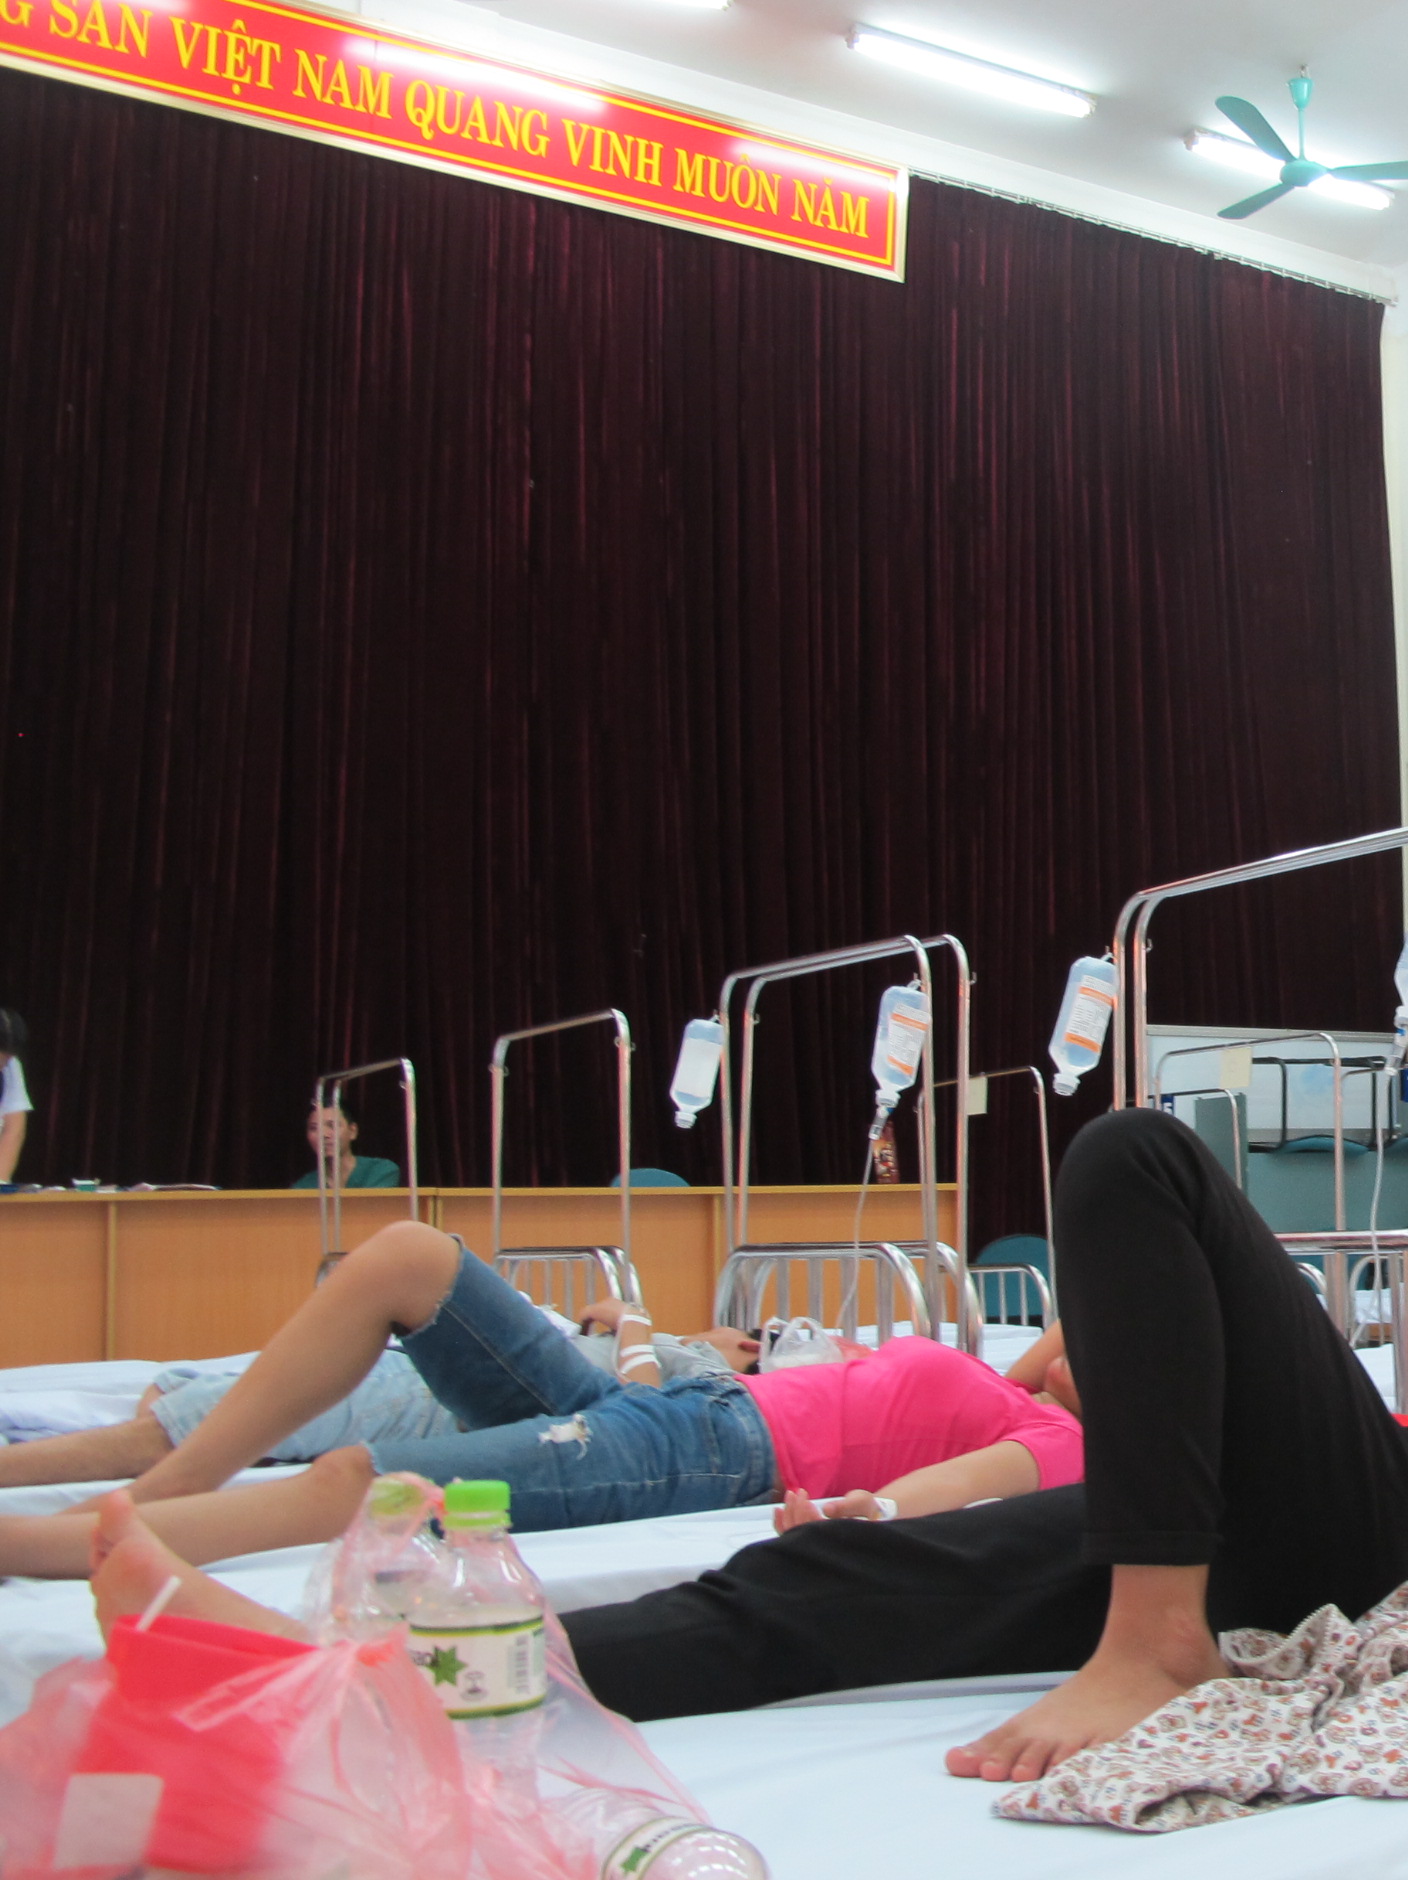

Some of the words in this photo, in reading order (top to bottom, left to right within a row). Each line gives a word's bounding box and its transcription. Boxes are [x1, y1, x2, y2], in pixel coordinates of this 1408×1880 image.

[169, 16, 281, 95] VIỆT
[293, 48, 394, 120] NAM
[404, 79, 551, 158] QUANG
[562, 119, 664, 187] VINH
[672, 147, 782, 216] MUÔN
[791, 176, 870, 239] NĂM
